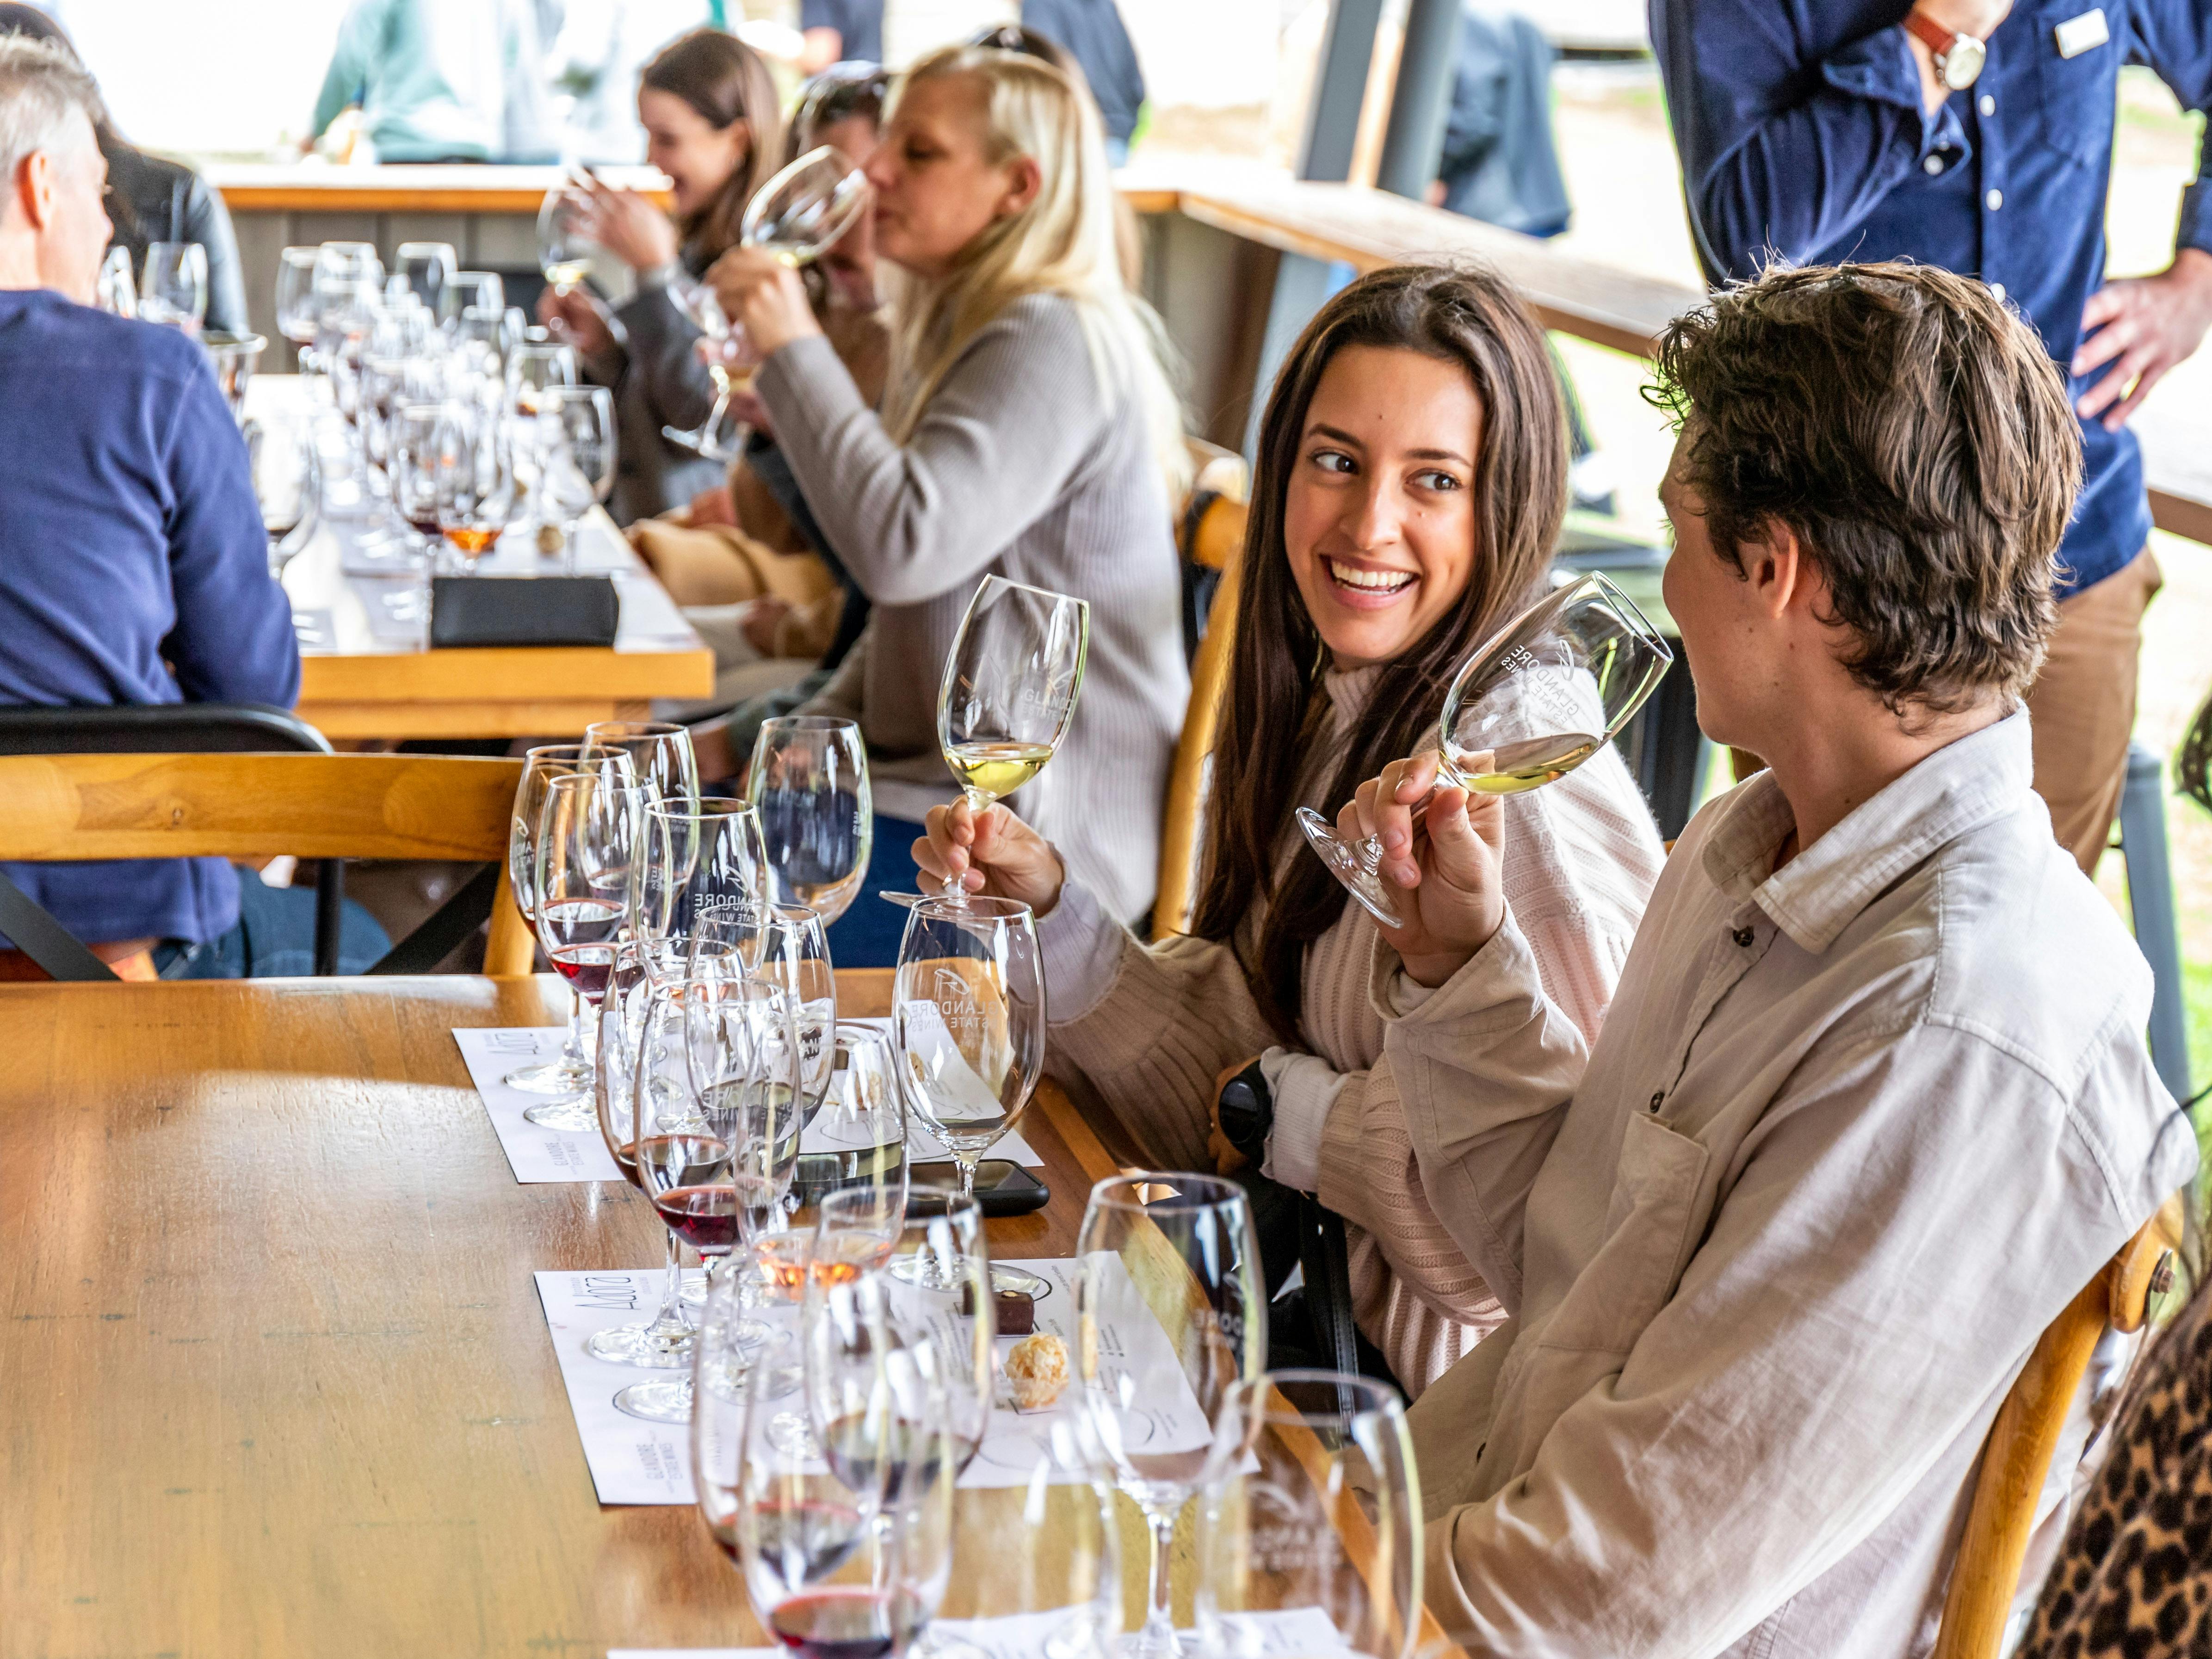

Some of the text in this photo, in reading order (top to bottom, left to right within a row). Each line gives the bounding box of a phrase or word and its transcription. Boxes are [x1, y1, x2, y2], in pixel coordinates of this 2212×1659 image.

[544, 1141, 569, 1166] GLANDORE
[568, 1153, 585, 1166] ESTATE
[573, 1277, 642, 1310] Adora
[636, 1443, 664, 1480] GLANDORE
